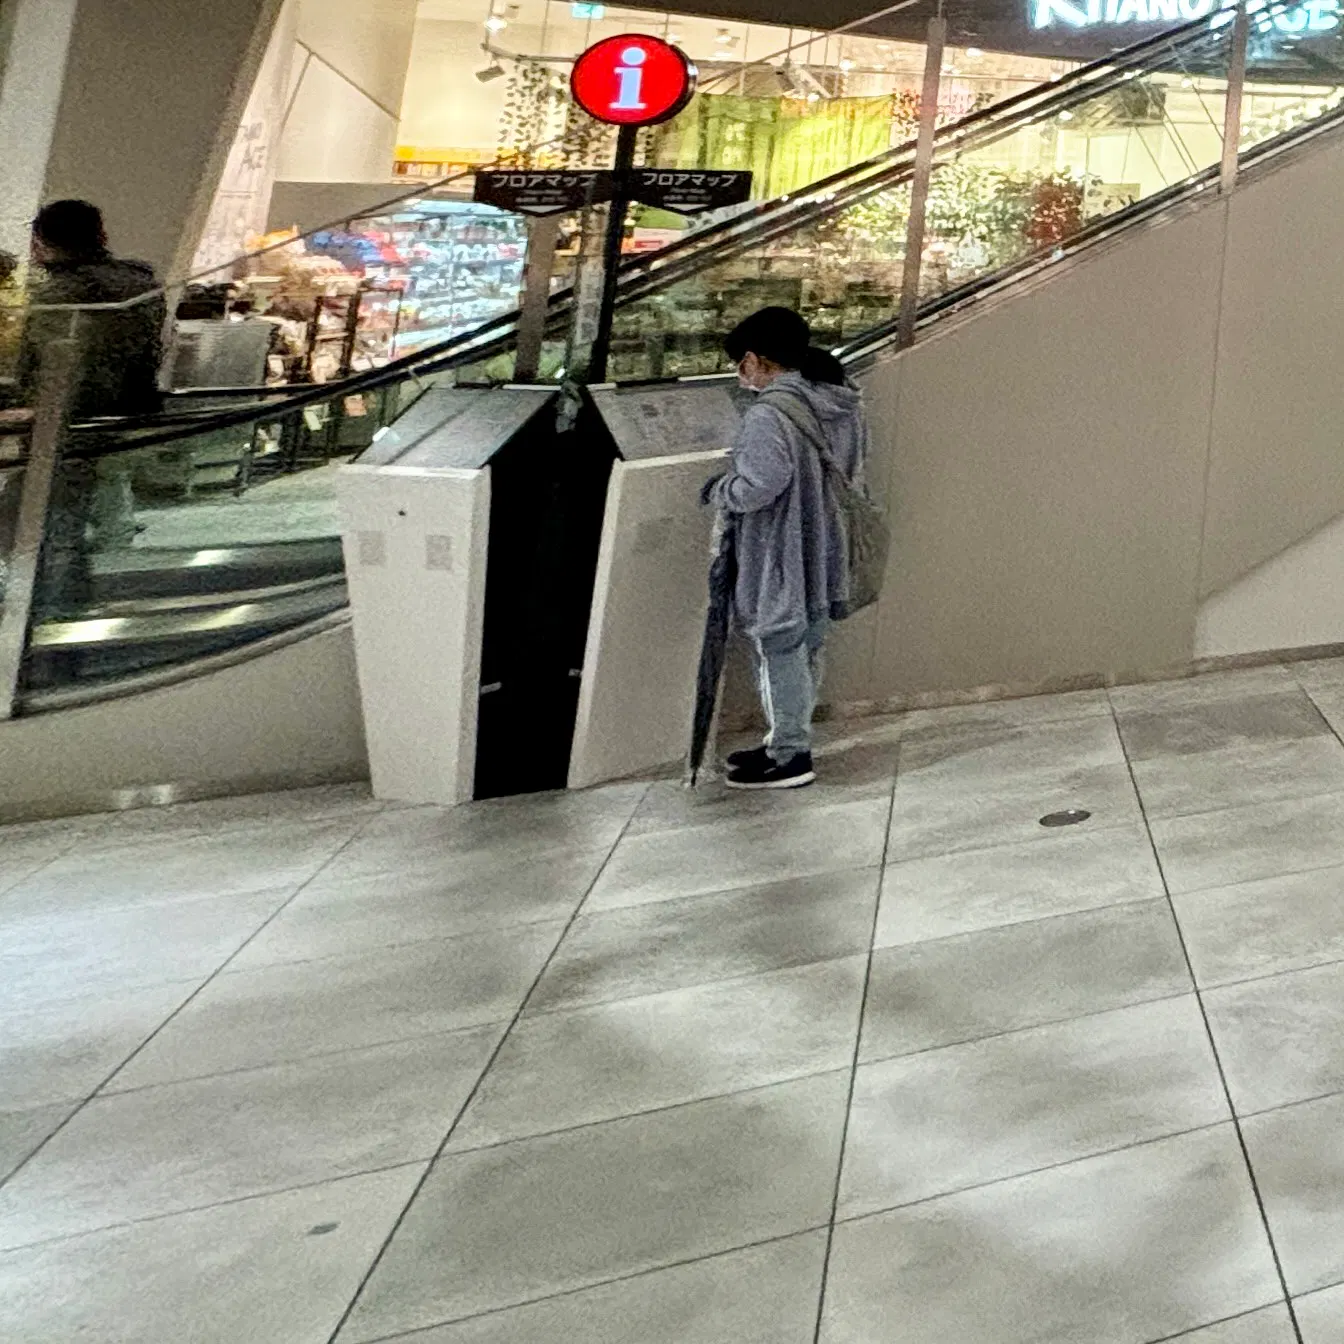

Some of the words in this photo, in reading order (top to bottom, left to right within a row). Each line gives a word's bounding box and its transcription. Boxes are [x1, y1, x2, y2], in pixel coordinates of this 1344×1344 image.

[492, 173, 599, 188] フロアマップ
[642, 172, 738, 188] フロアマップ
